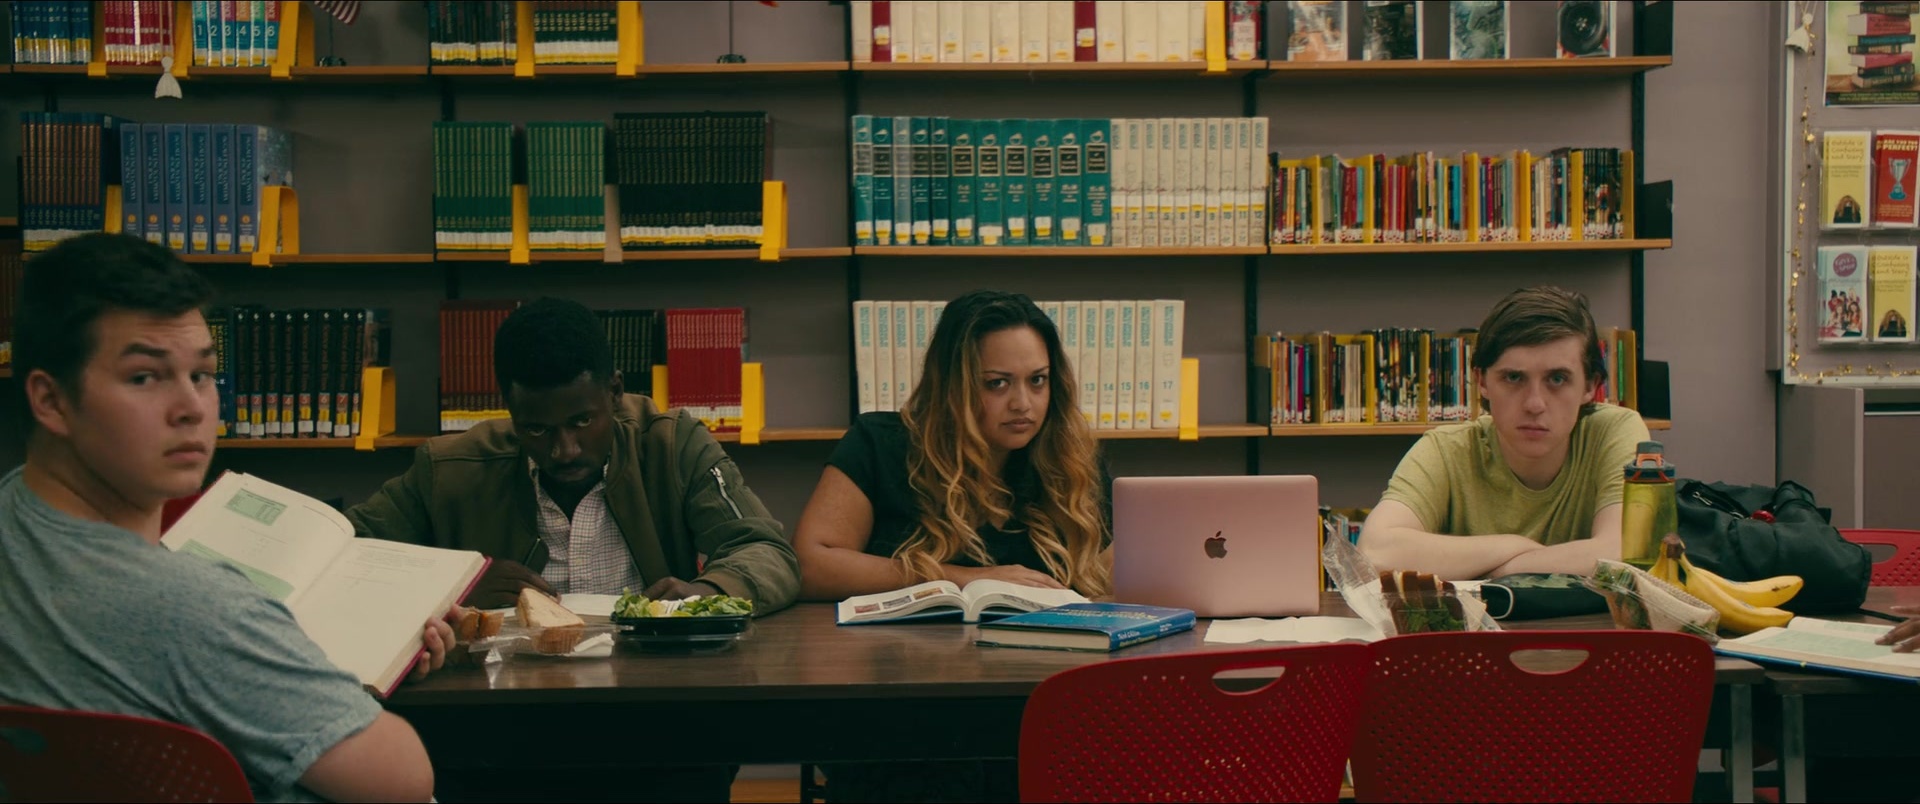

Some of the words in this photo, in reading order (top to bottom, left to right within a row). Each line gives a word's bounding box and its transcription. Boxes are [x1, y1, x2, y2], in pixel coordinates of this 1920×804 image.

[197, 25, 202, 36] 1
[210, 25, 218, 36] 2
[224, 25, 232, 36] 3
[240, 25, 247, 36] 4
[254, 26, 261, 37] 5
[267, 26, 276, 37] 6
[882, 382, 888, 392] 2
[1121, 382, 1131, 390] 15
[1163, 381, 1173, 389] 17
